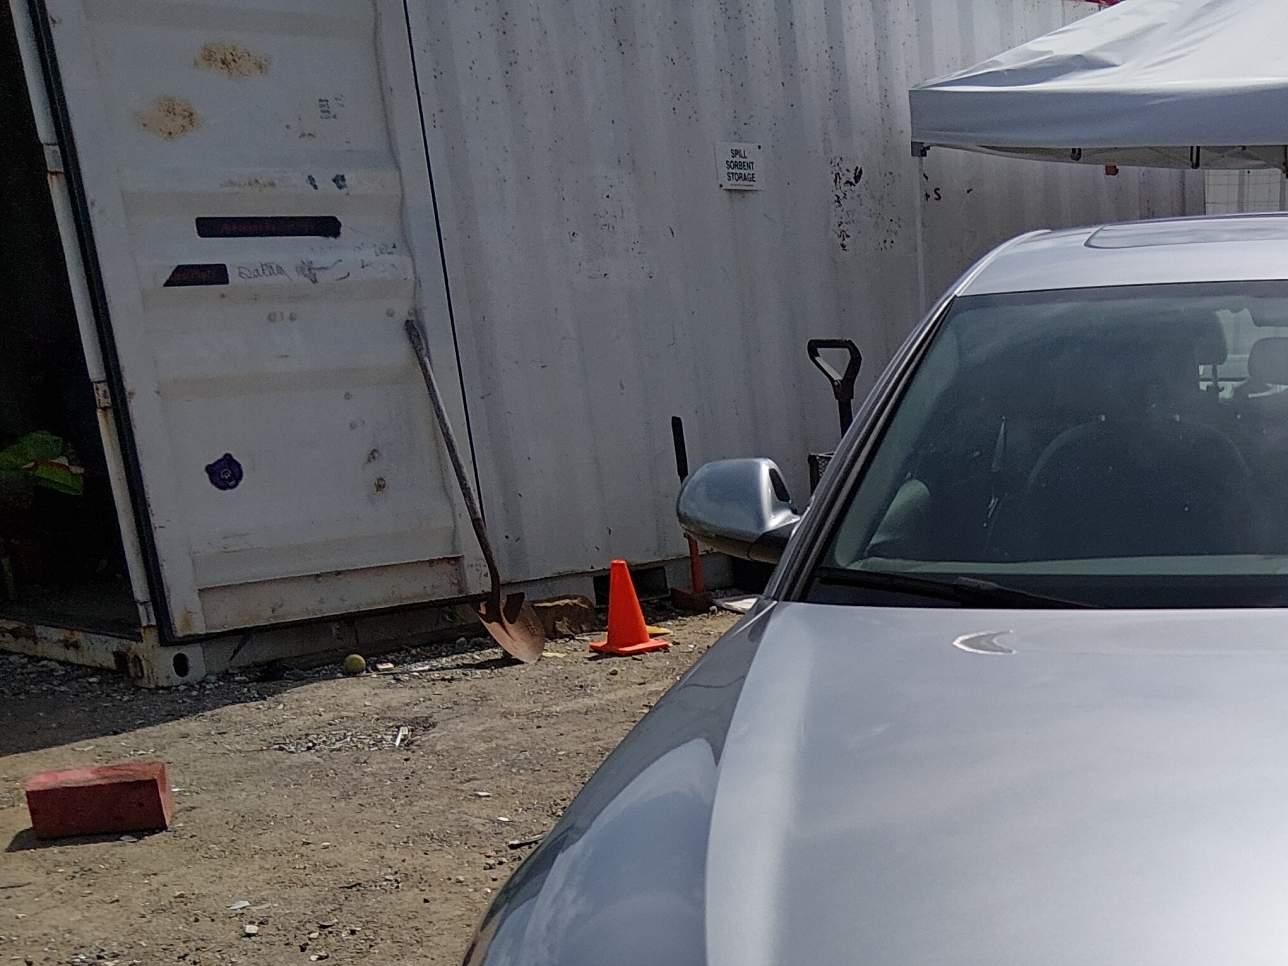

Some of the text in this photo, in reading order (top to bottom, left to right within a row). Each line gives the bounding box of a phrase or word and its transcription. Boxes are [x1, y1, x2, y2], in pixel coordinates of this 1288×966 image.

[730, 148, 748, 159] SPILL
[725, 160, 754, 170] SORBENT
[726, 171, 756, 182] STORAGE
